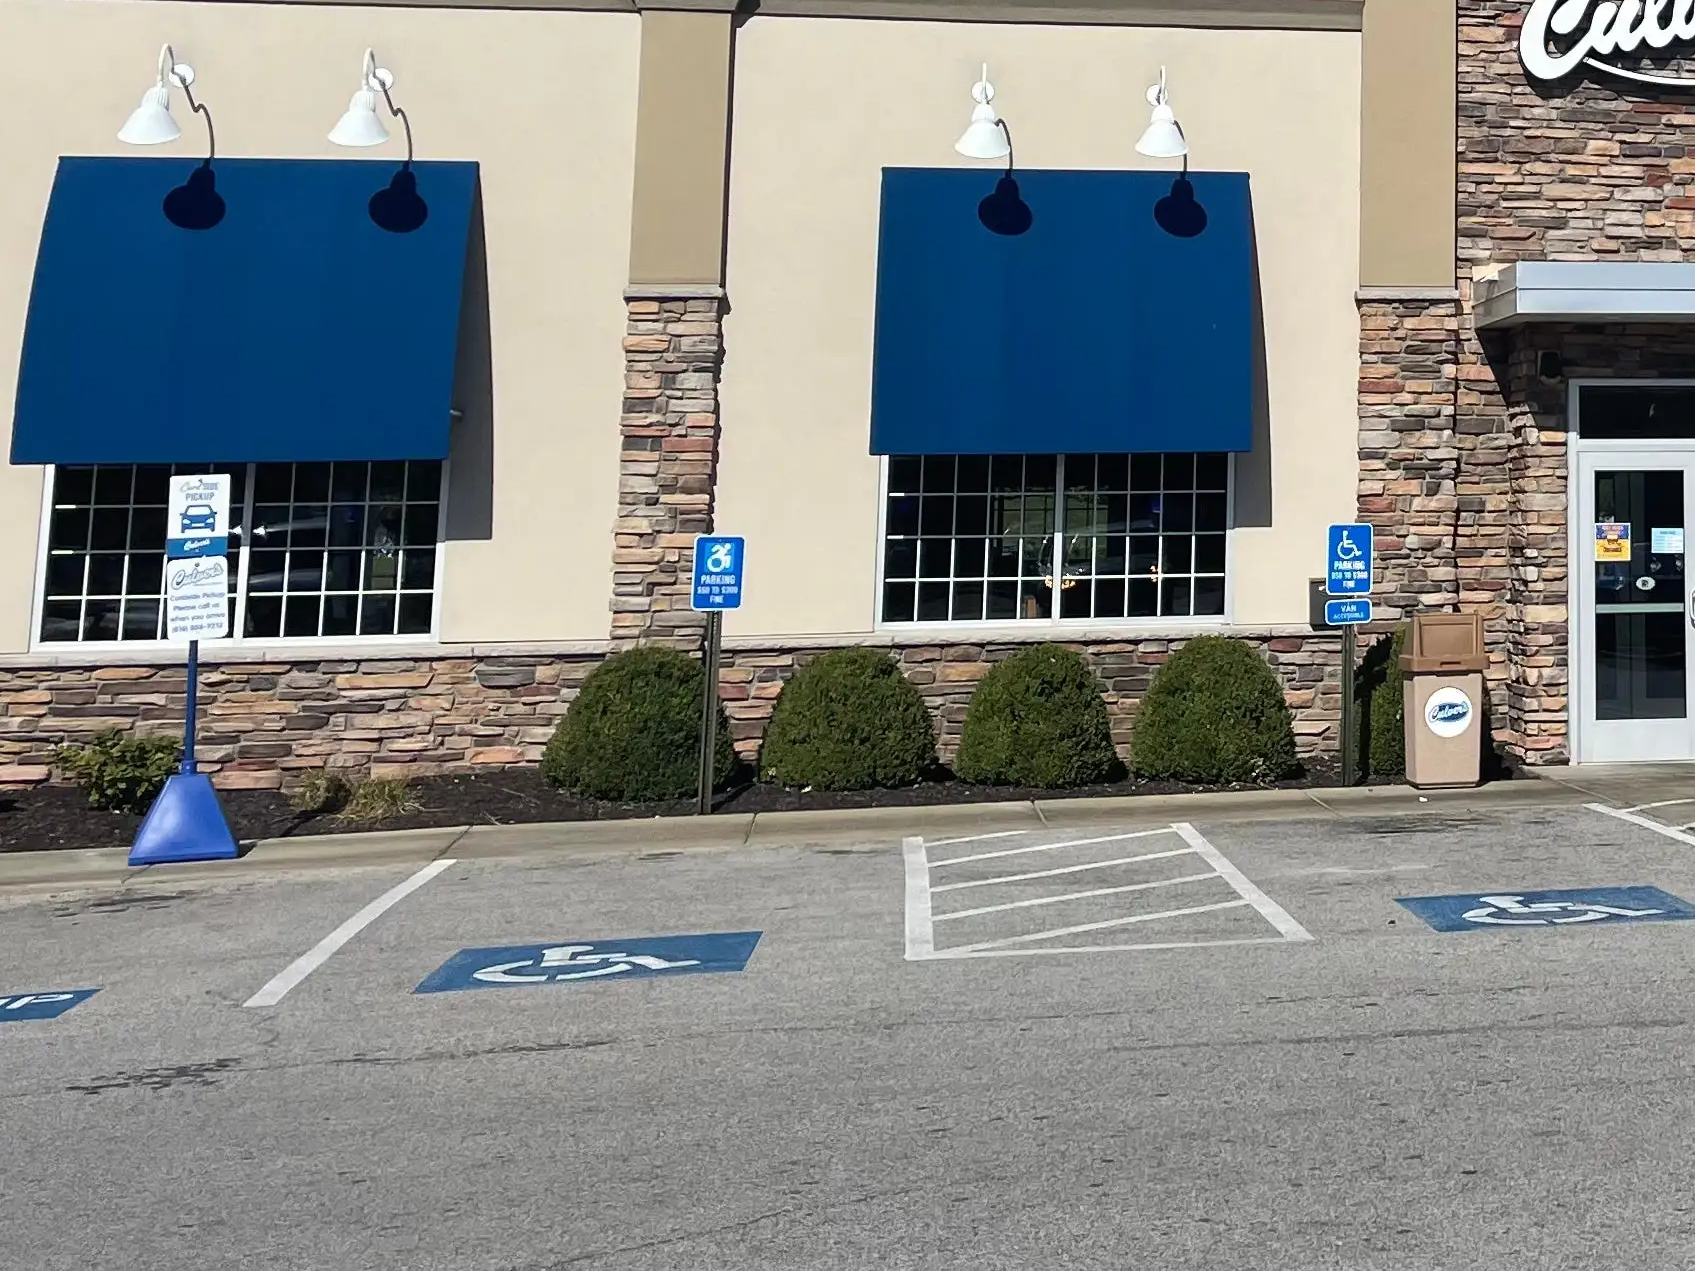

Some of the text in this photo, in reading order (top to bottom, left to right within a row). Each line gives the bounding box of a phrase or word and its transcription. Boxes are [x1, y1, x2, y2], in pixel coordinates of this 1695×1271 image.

[185, 492, 215, 501] PICKUP
[1333, 561, 1365, 570] PARKING
[171, 563, 224, 590] Culver's
[701, 575, 736, 585] PARKING
[712, 586, 720, 594] TO
[710, 595, 724, 603] FINE
[1428, 700, 1469, 723] Culver's
